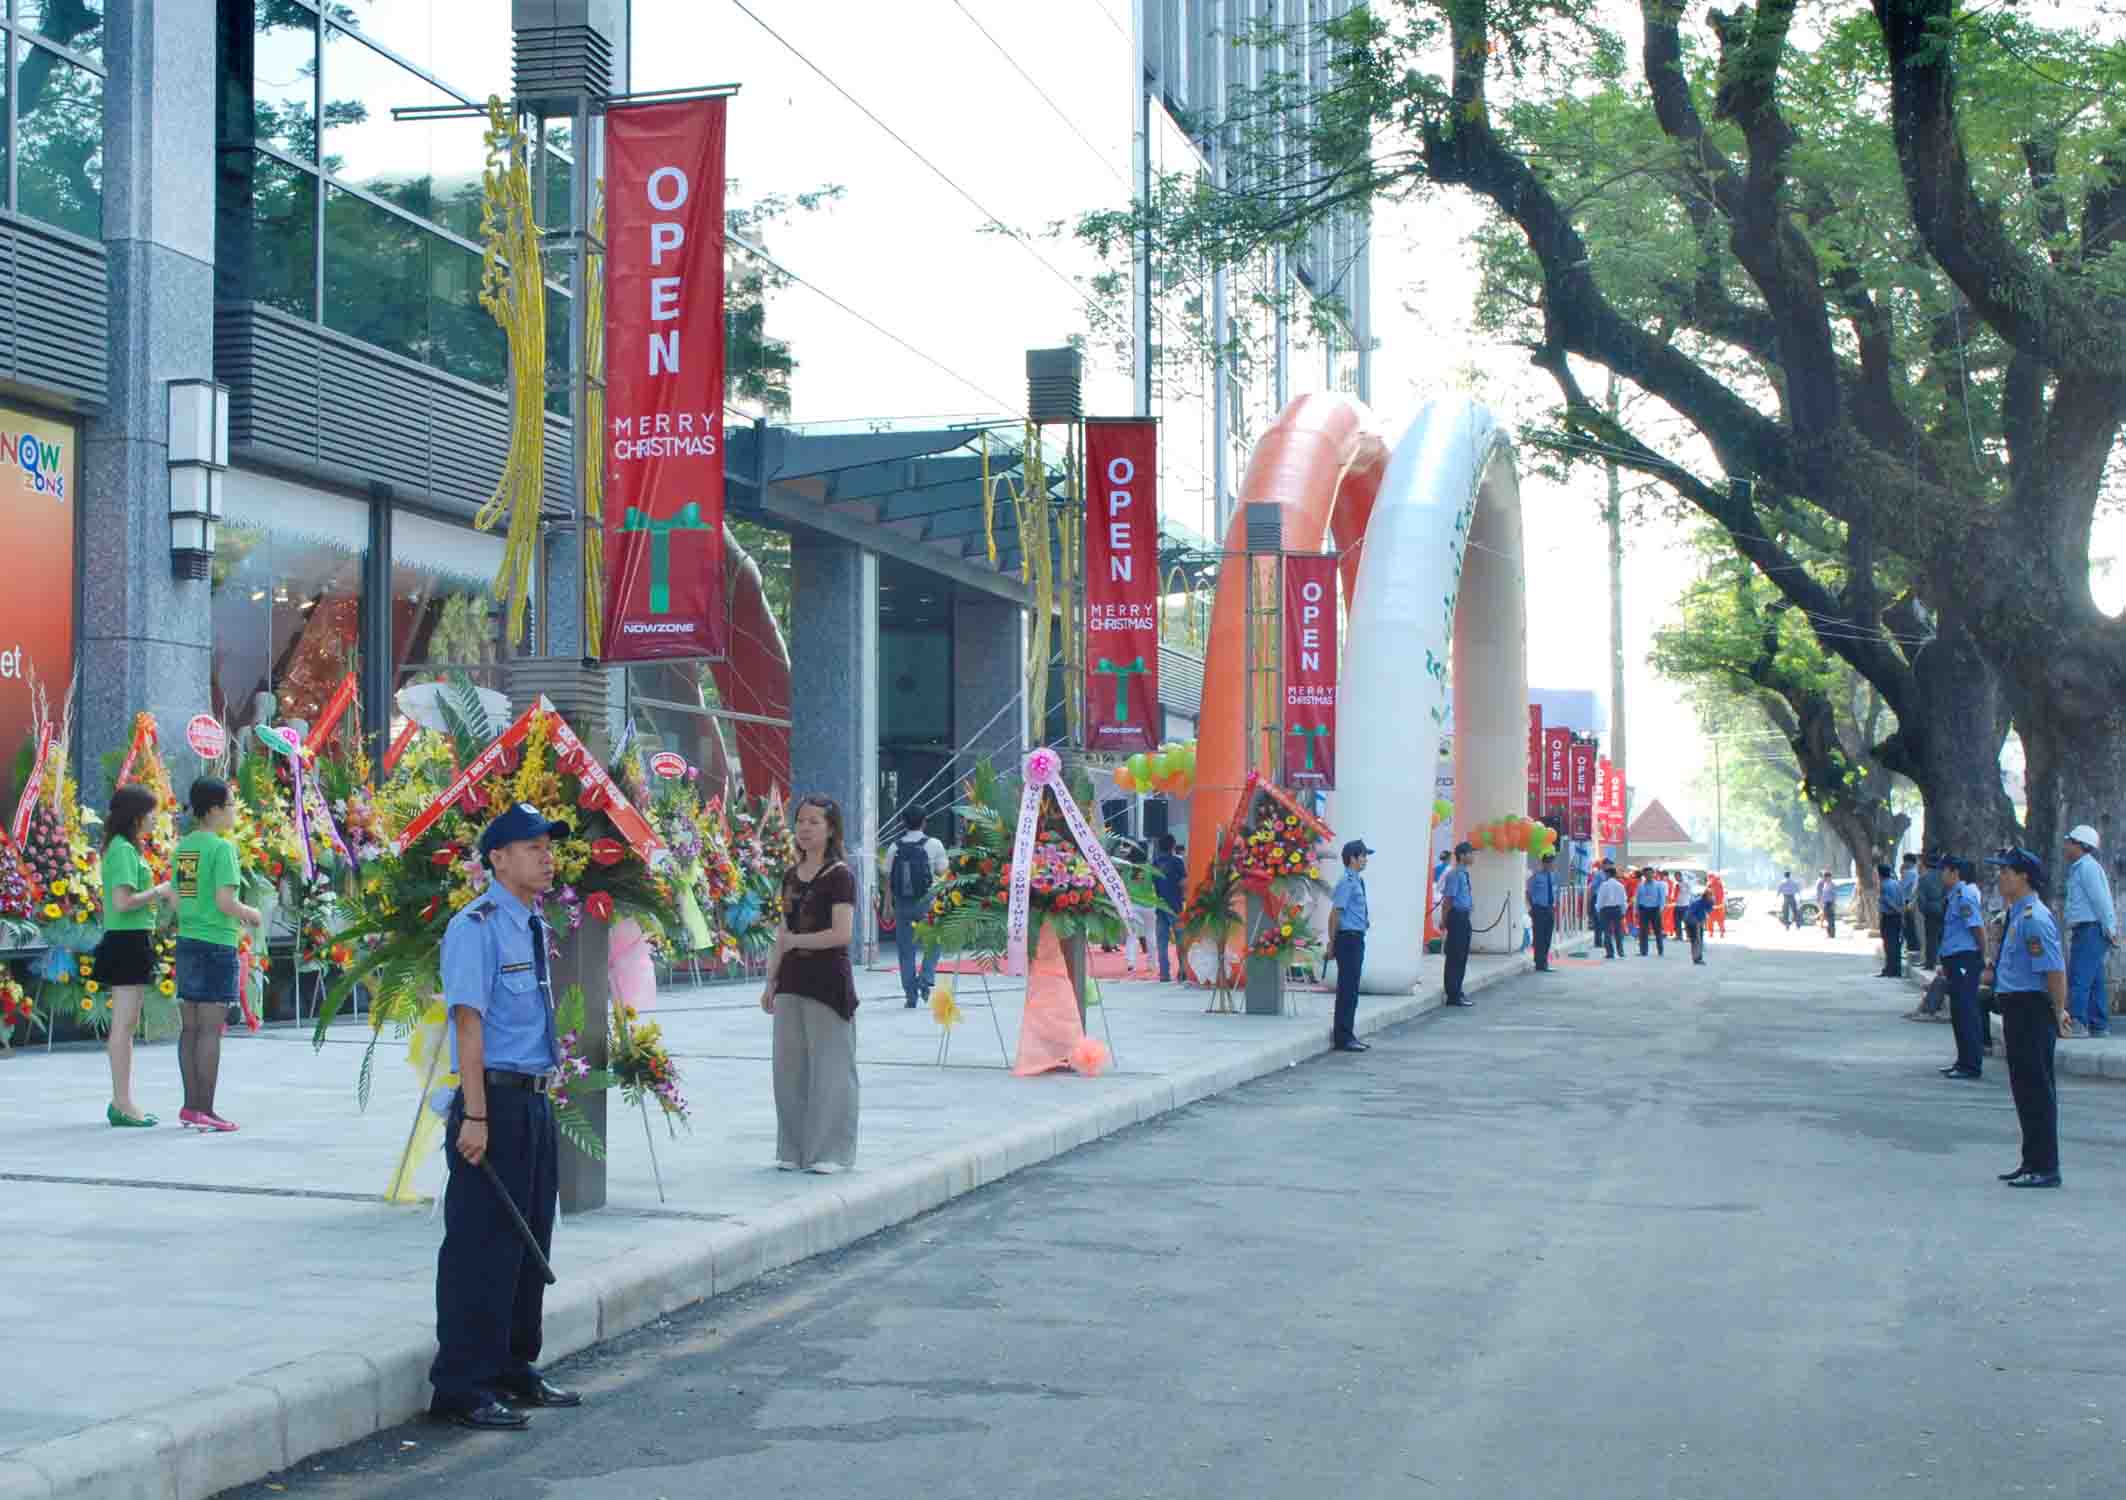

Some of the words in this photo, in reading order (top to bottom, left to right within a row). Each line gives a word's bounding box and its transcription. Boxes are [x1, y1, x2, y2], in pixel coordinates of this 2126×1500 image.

[647, 166, 689, 376] OPEN
[615, 413, 714, 437] MERRY
[0, 432, 60, 473] NOW
[615, 435, 716, 460] CHRISTMAS
[1108, 457, 1135, 583] OPEN
[1091, 604, 1153, 617] MERRY
[1091, 617, 1153, 631] CHRISTMAS
[1301, 582, 1323, 672] OPEN
[624, 623, 695, 633] NOWZONE
[1552, 740, 1561, 781] OPEN
